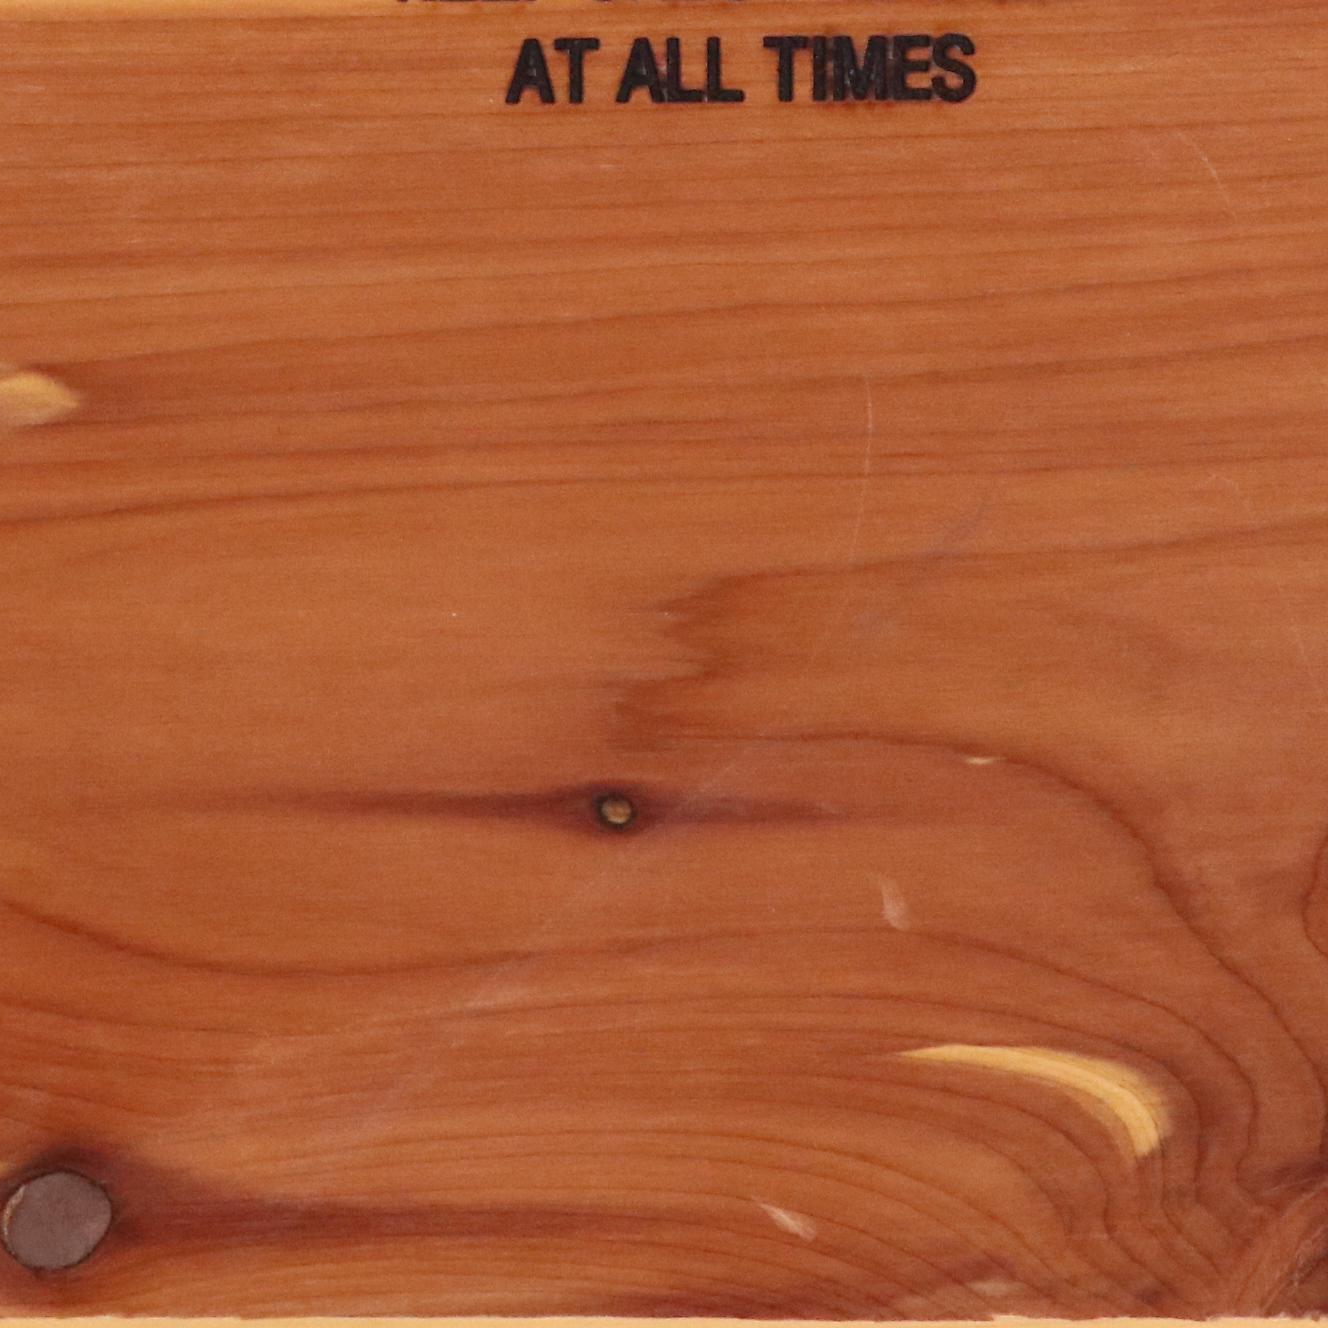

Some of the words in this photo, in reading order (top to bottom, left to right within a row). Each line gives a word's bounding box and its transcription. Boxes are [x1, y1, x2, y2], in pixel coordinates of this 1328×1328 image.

[504, 36, 601, 105] AT
[615, 36, 745, 104] ALL
[762, 33, 978, 104] TIMES
